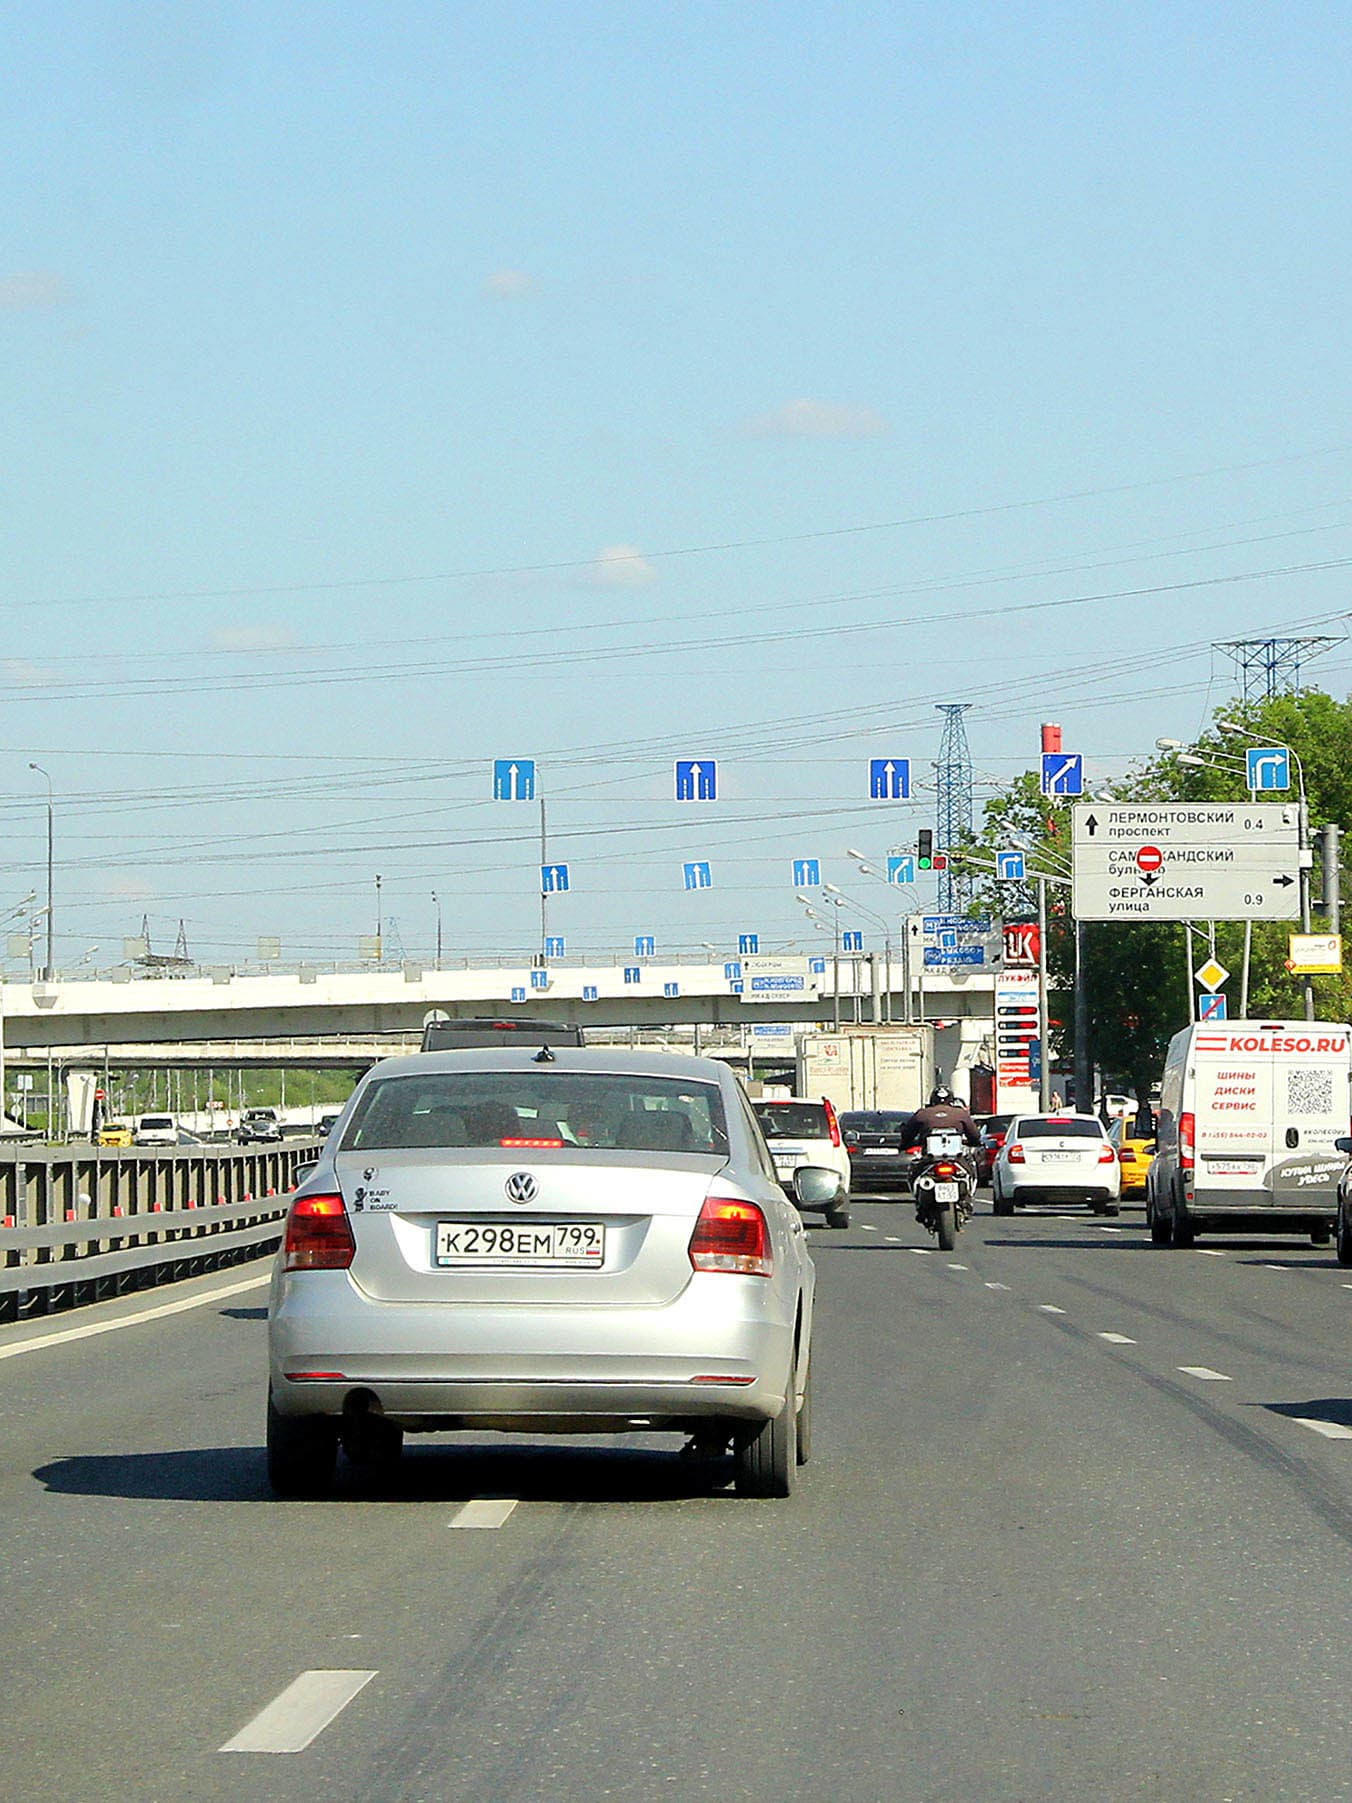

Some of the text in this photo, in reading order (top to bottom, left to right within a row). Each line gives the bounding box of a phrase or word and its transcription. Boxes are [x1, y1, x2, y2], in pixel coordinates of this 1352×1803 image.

[1108, 810, 1235, 824] ЛЕРМОНТОВСКИЙ
[1243, 818, 1264, 830] 0.4
[1108, 827, 1171, 838] проспект
[1108, 849, 1234, 864] САМКАНДСКИЙ
[1108, 886, 1204, 899] ФЕРГАНСКАЯ
[1243, 893, 1264, 906] 0.9
[1108, 902, 1150, 914] улица
[1230, 1037, 1346, 1053] KOLESO.RU
[1217, 1071, 1256, 1080] ШИНЫ
[1214, 1087, 1256, 1096] ДИСКИ
[1211, 1102, 1257, 1111] СЕРВИС
[446, 1227, 597, 1254] К298ЕМ 799
[565, 1246, 585, 1255] RUS
